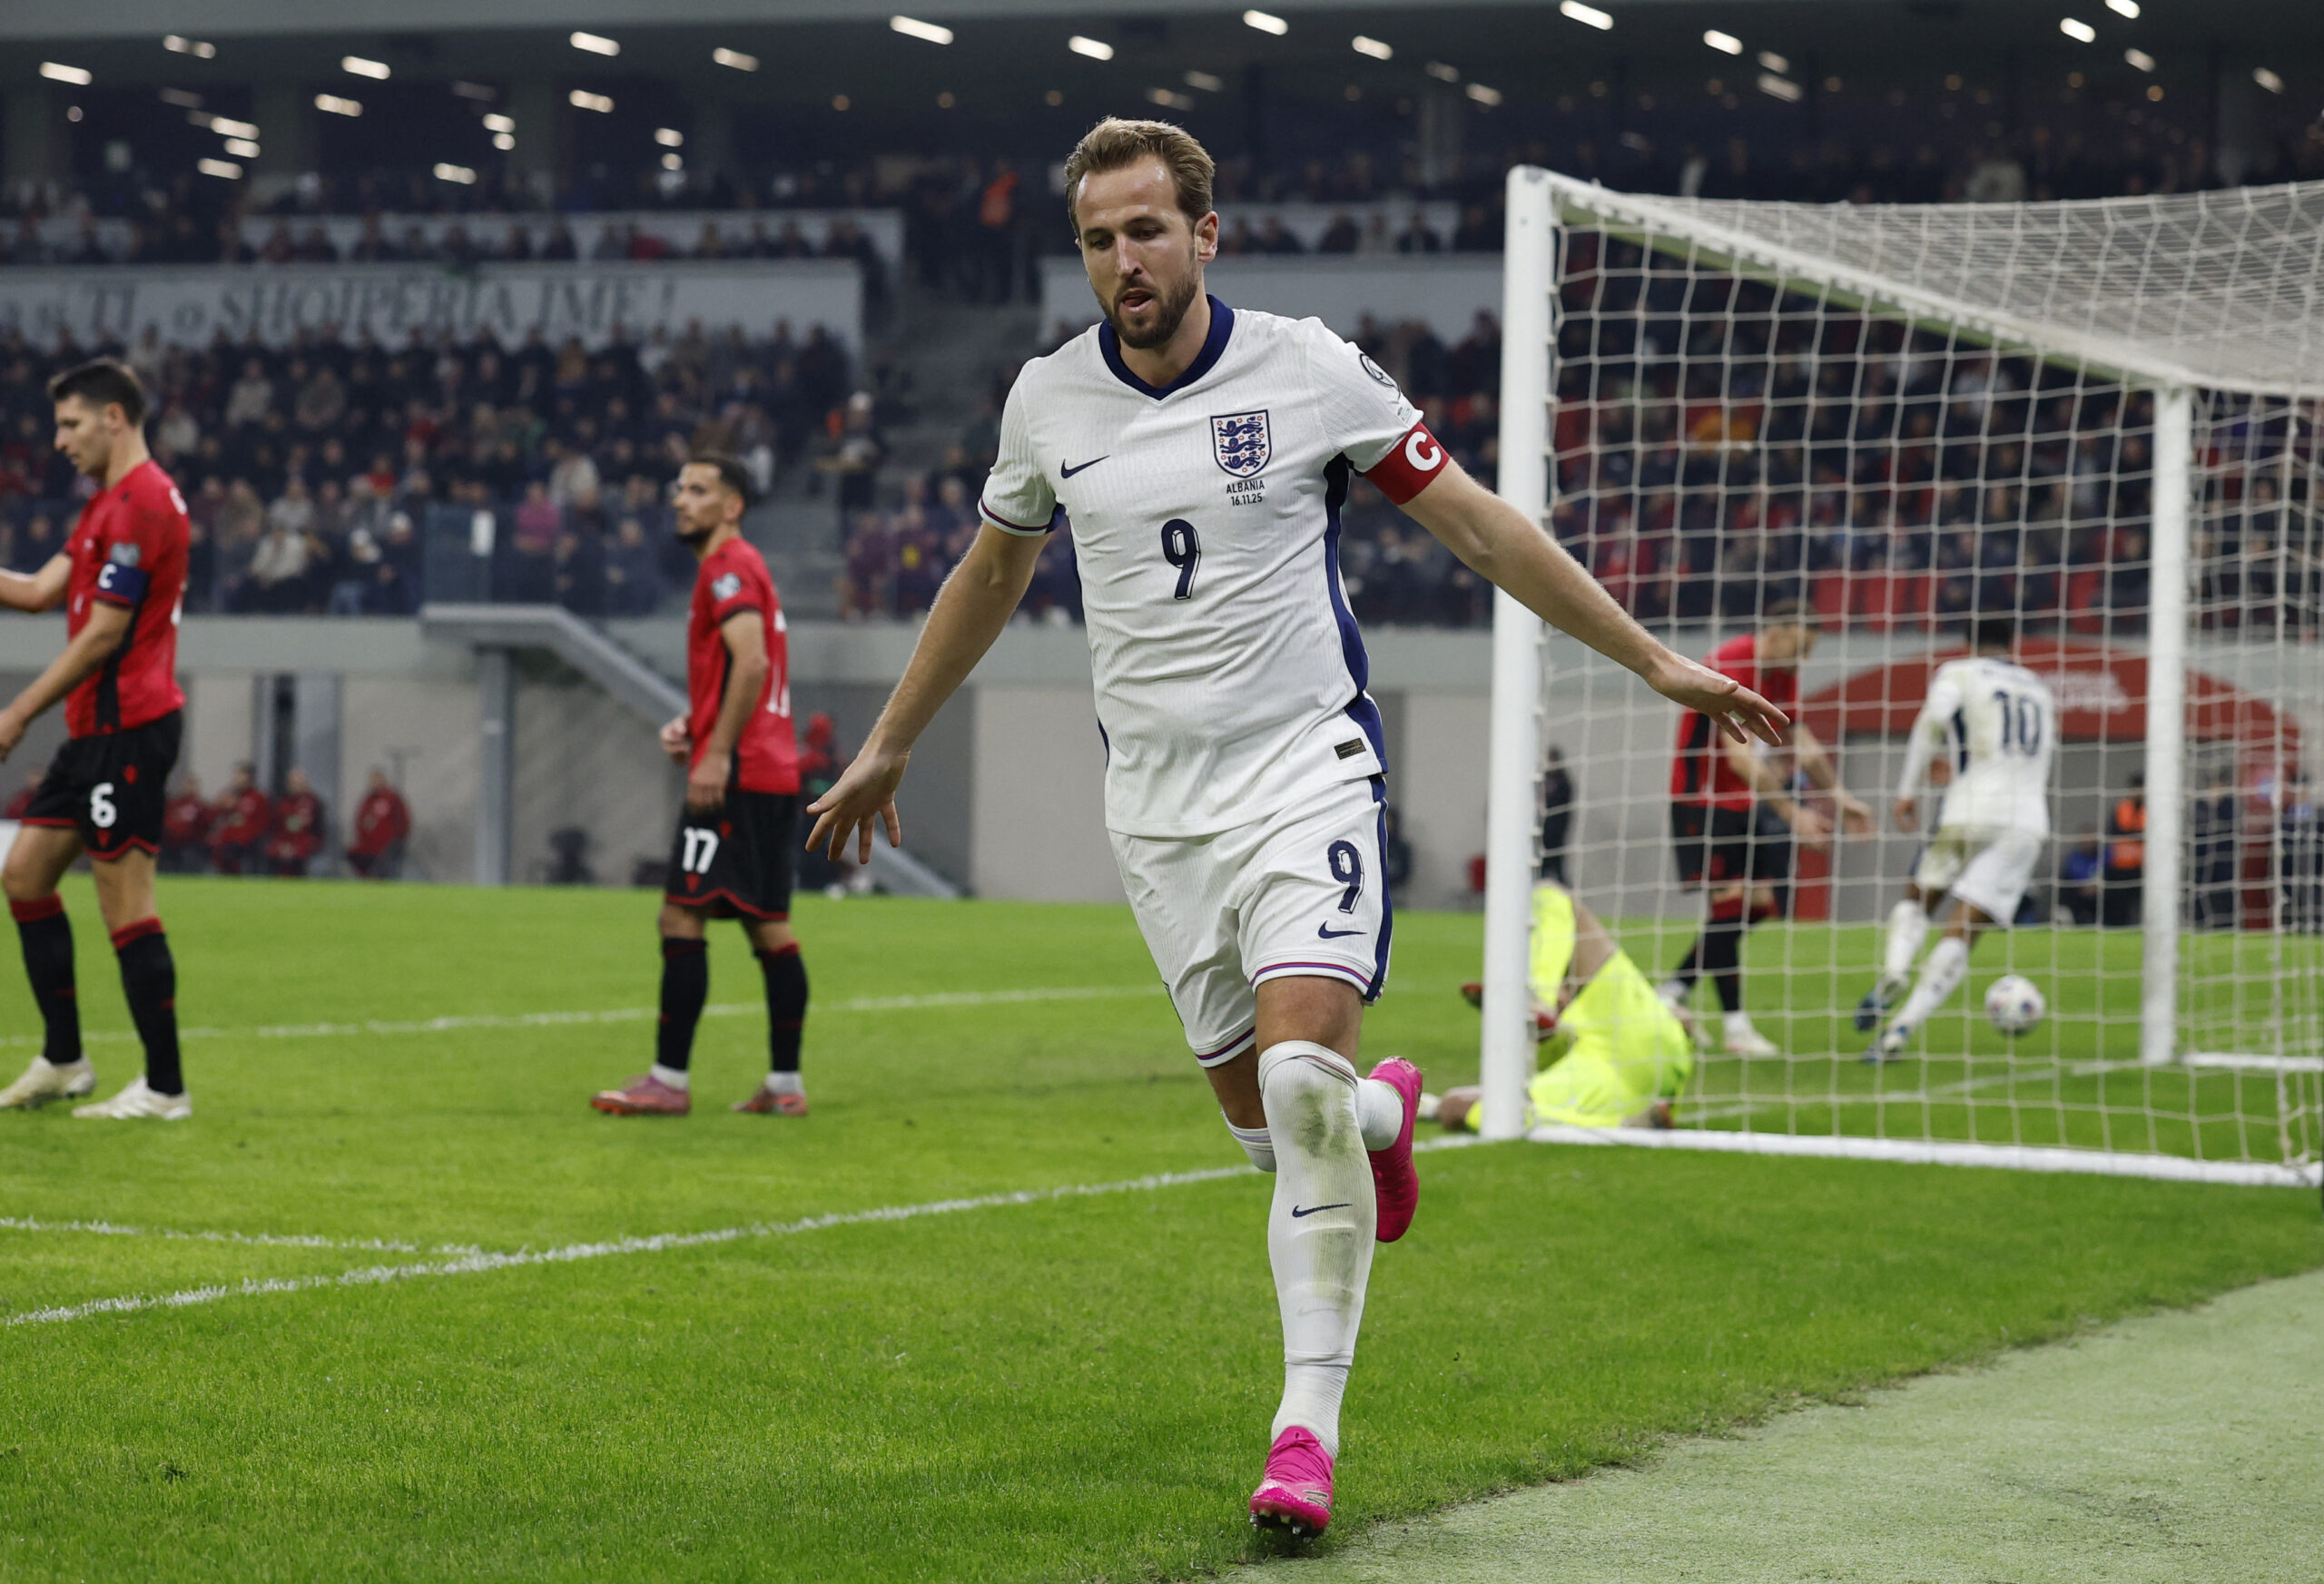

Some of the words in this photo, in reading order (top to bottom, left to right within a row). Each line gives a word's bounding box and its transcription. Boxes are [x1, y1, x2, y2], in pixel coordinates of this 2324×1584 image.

[1404, 430, 1443, 471] C
[1226, 480, 1265, 494] ALBANIA
[1231, 493, 1263, 506] 16.11.25
[97, 563, 117, 589] C
[1161, 518, 1201, 601] 9
[1993, 689, 2043, 757] 10
[90, 782, 117, 828] 6
[683, 826, 720, 875] 17
[1327, 839, 1365, 915] 9
